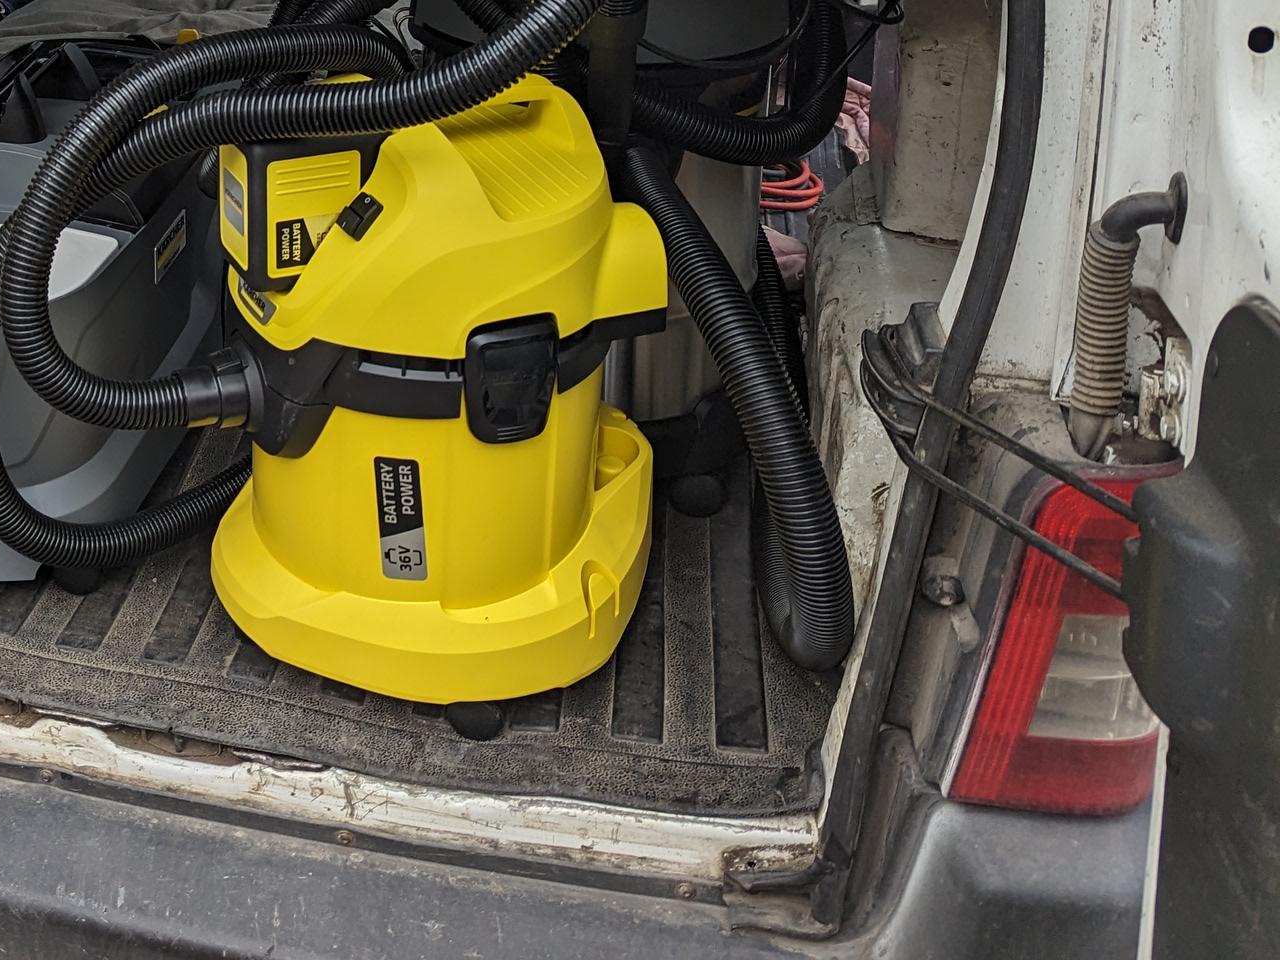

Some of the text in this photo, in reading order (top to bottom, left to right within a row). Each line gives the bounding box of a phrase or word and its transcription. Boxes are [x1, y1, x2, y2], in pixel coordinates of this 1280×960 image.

[281, 227, 290, 261] POWER
[292, 222, 301, 262] BATTERY
[380, 463, 397, 524] BATTERY
[399, 465, 415, 515] POWER
[398, 545, 412, 572] 36V
